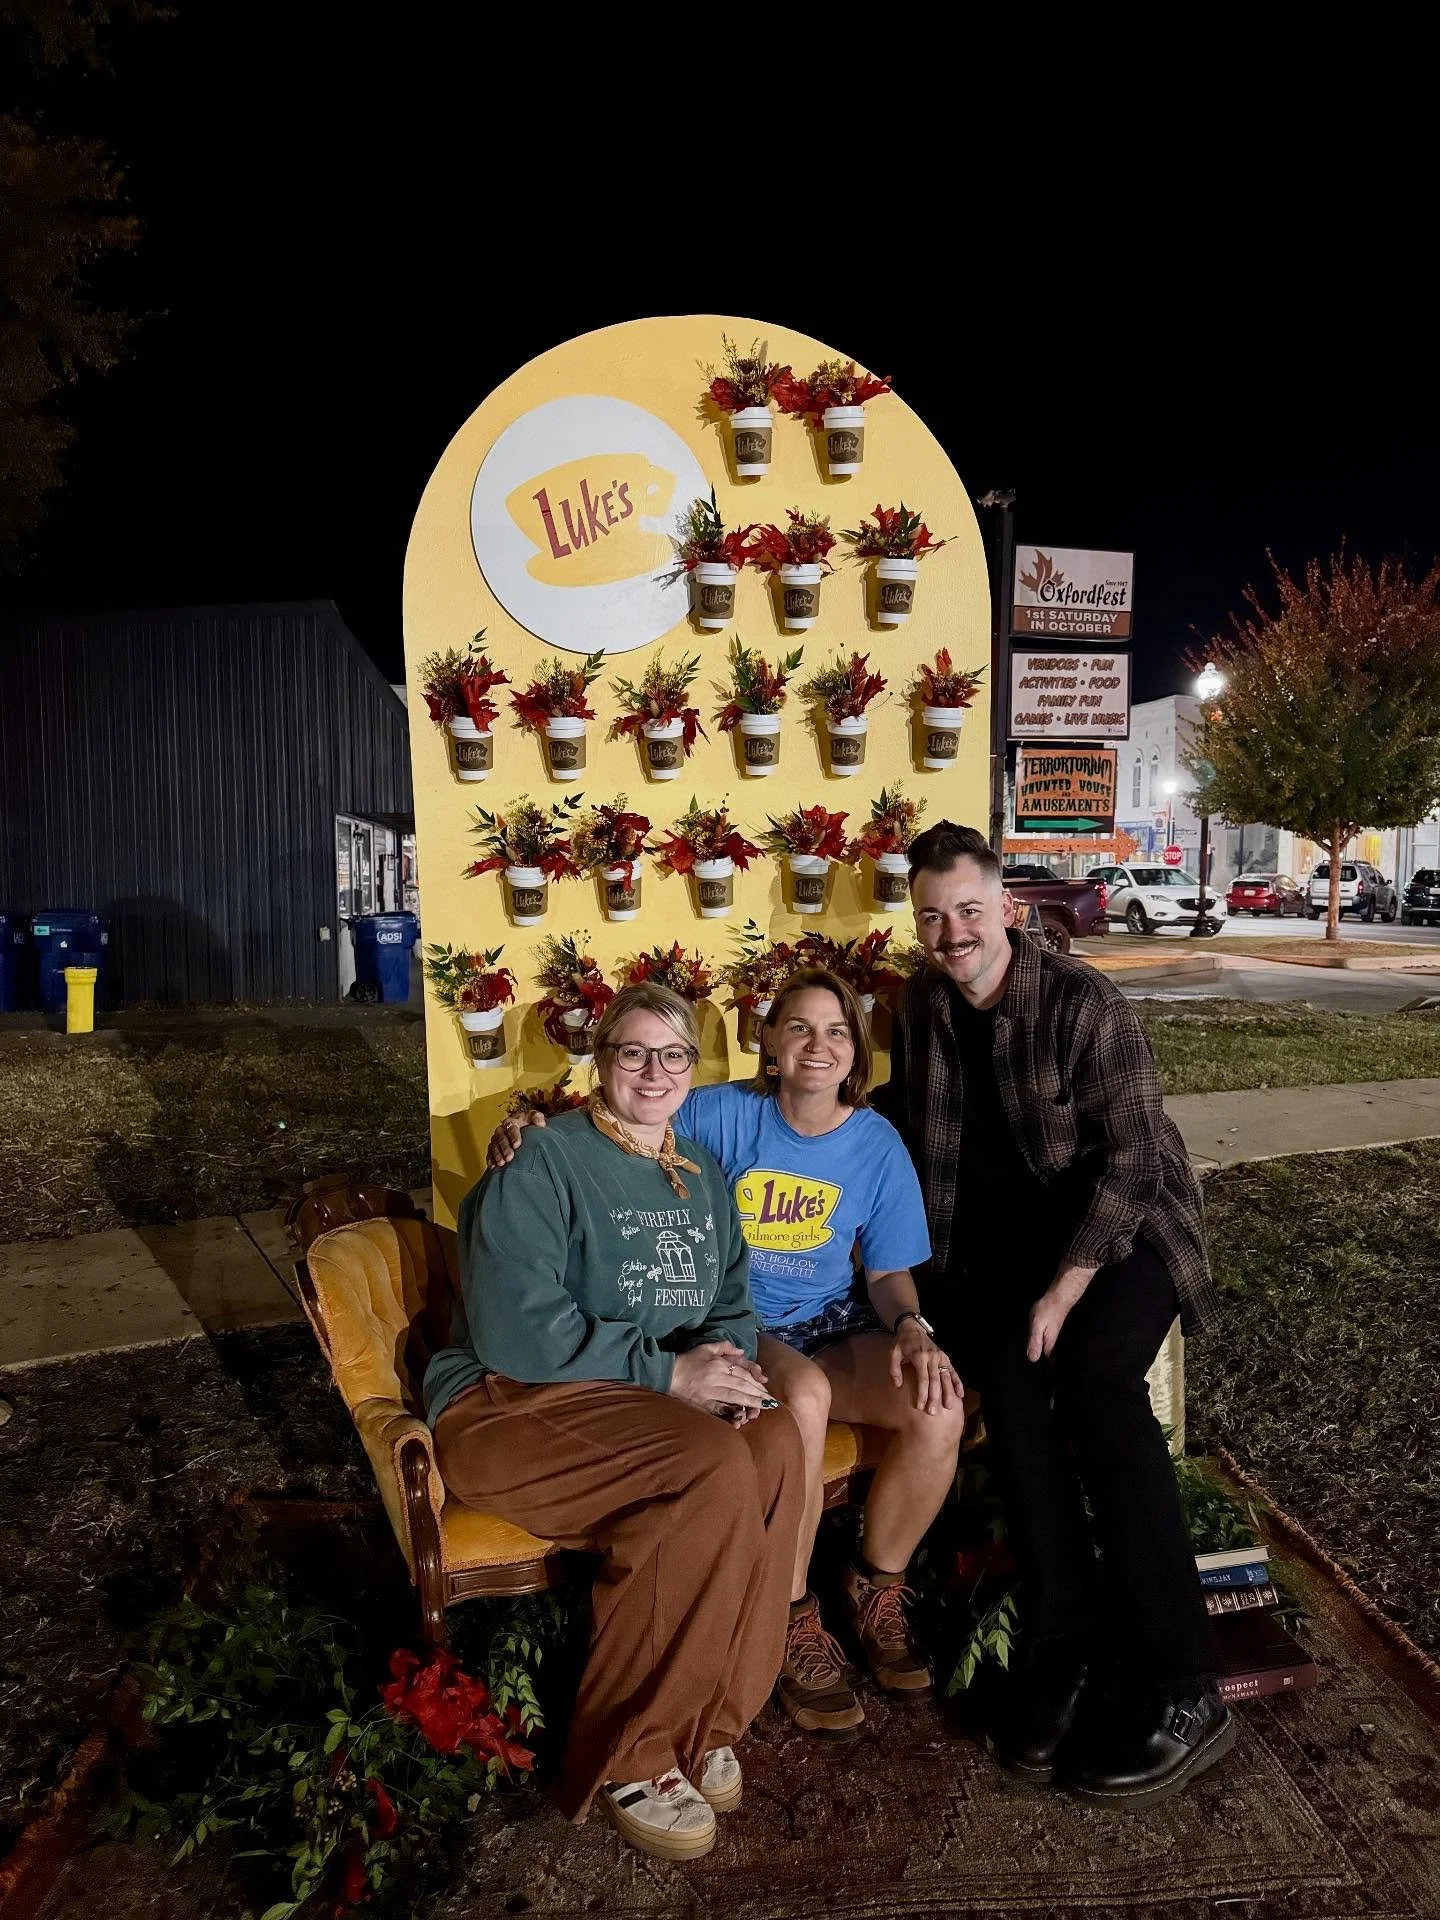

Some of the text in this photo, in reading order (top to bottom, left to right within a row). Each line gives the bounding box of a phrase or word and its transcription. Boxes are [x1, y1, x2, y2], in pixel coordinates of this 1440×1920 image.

[1040, 580, 1127, 607] Oxfordfest
[1025, 610, 1118, 623] 1st SATURDAY
[1030, 621, 1112, 633] IN OCTOBER
[1027, 658, 1114, 671] VENDORS FUN
[1018, 676, 1121, 689] ACTIVITIES FOOD
[1037, 695, 1103, 707] FAMILY FUN
[1014, 712, 1126, 725] GAMES LIVE MUSIC
[1022, 756, 1113, 782] TERRORTORIUM
[1021, 778, 1112, 798] HAUNTED HOUSE
[1022, 799, 1110, 812] AMUSEMENTS
[1164, 852, 1182, 860] STOP
[636, 1209, 691, 1227] FIREFLY
[791, 1226, 820, 1248] girls
[769, 1253, 819, 1269] HOLLOW
[654, 1288, 705, 1307] FESTIVAL
